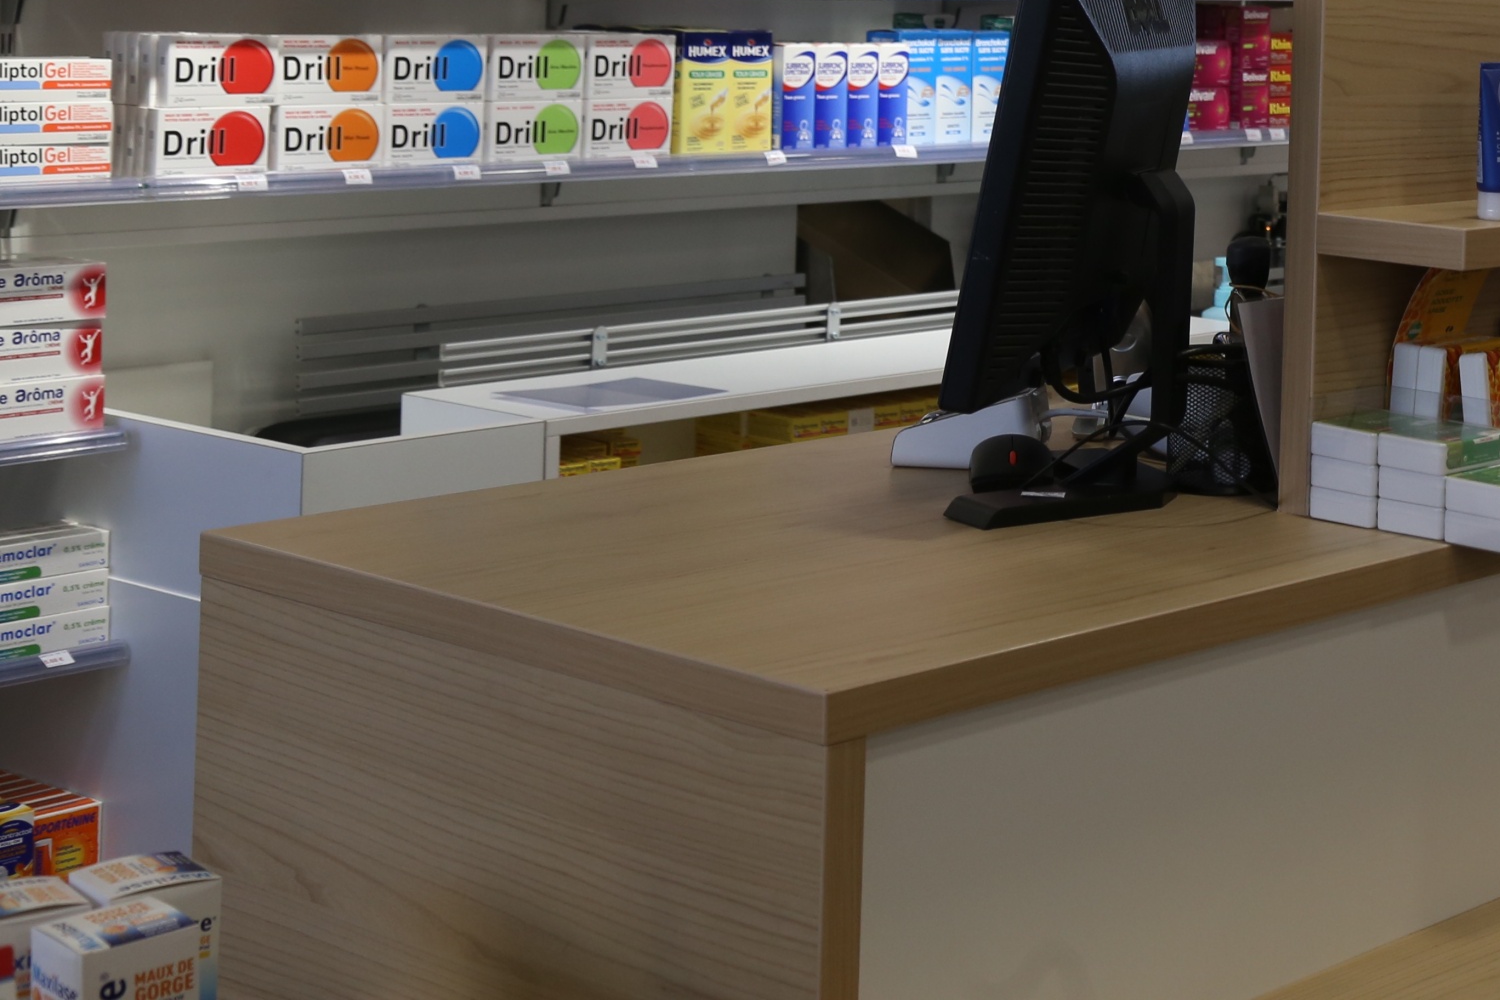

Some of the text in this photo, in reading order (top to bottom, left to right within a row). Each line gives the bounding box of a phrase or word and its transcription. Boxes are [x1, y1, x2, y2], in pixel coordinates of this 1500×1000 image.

[175, 56, 235, 82] Drill
[284, 55, 341, 80] Drill
[394, 56, 448, 80] Drill
[499, 56, 548, 81] Drill
[595, 54, 642, 78] Drill
[164, 128, 225, 156] Drill
[285, 126, 342, 151] Drill
[392, 123, 445, 148] Drill
[84, 541, 105, 551] crème
[83, 580, 105, 590] crème
[34, 812, 96, 836] SPORTÉNINE
[134, 957, 194, 986] MAUX DE
[134, 973, 195, 1000] GORGE
